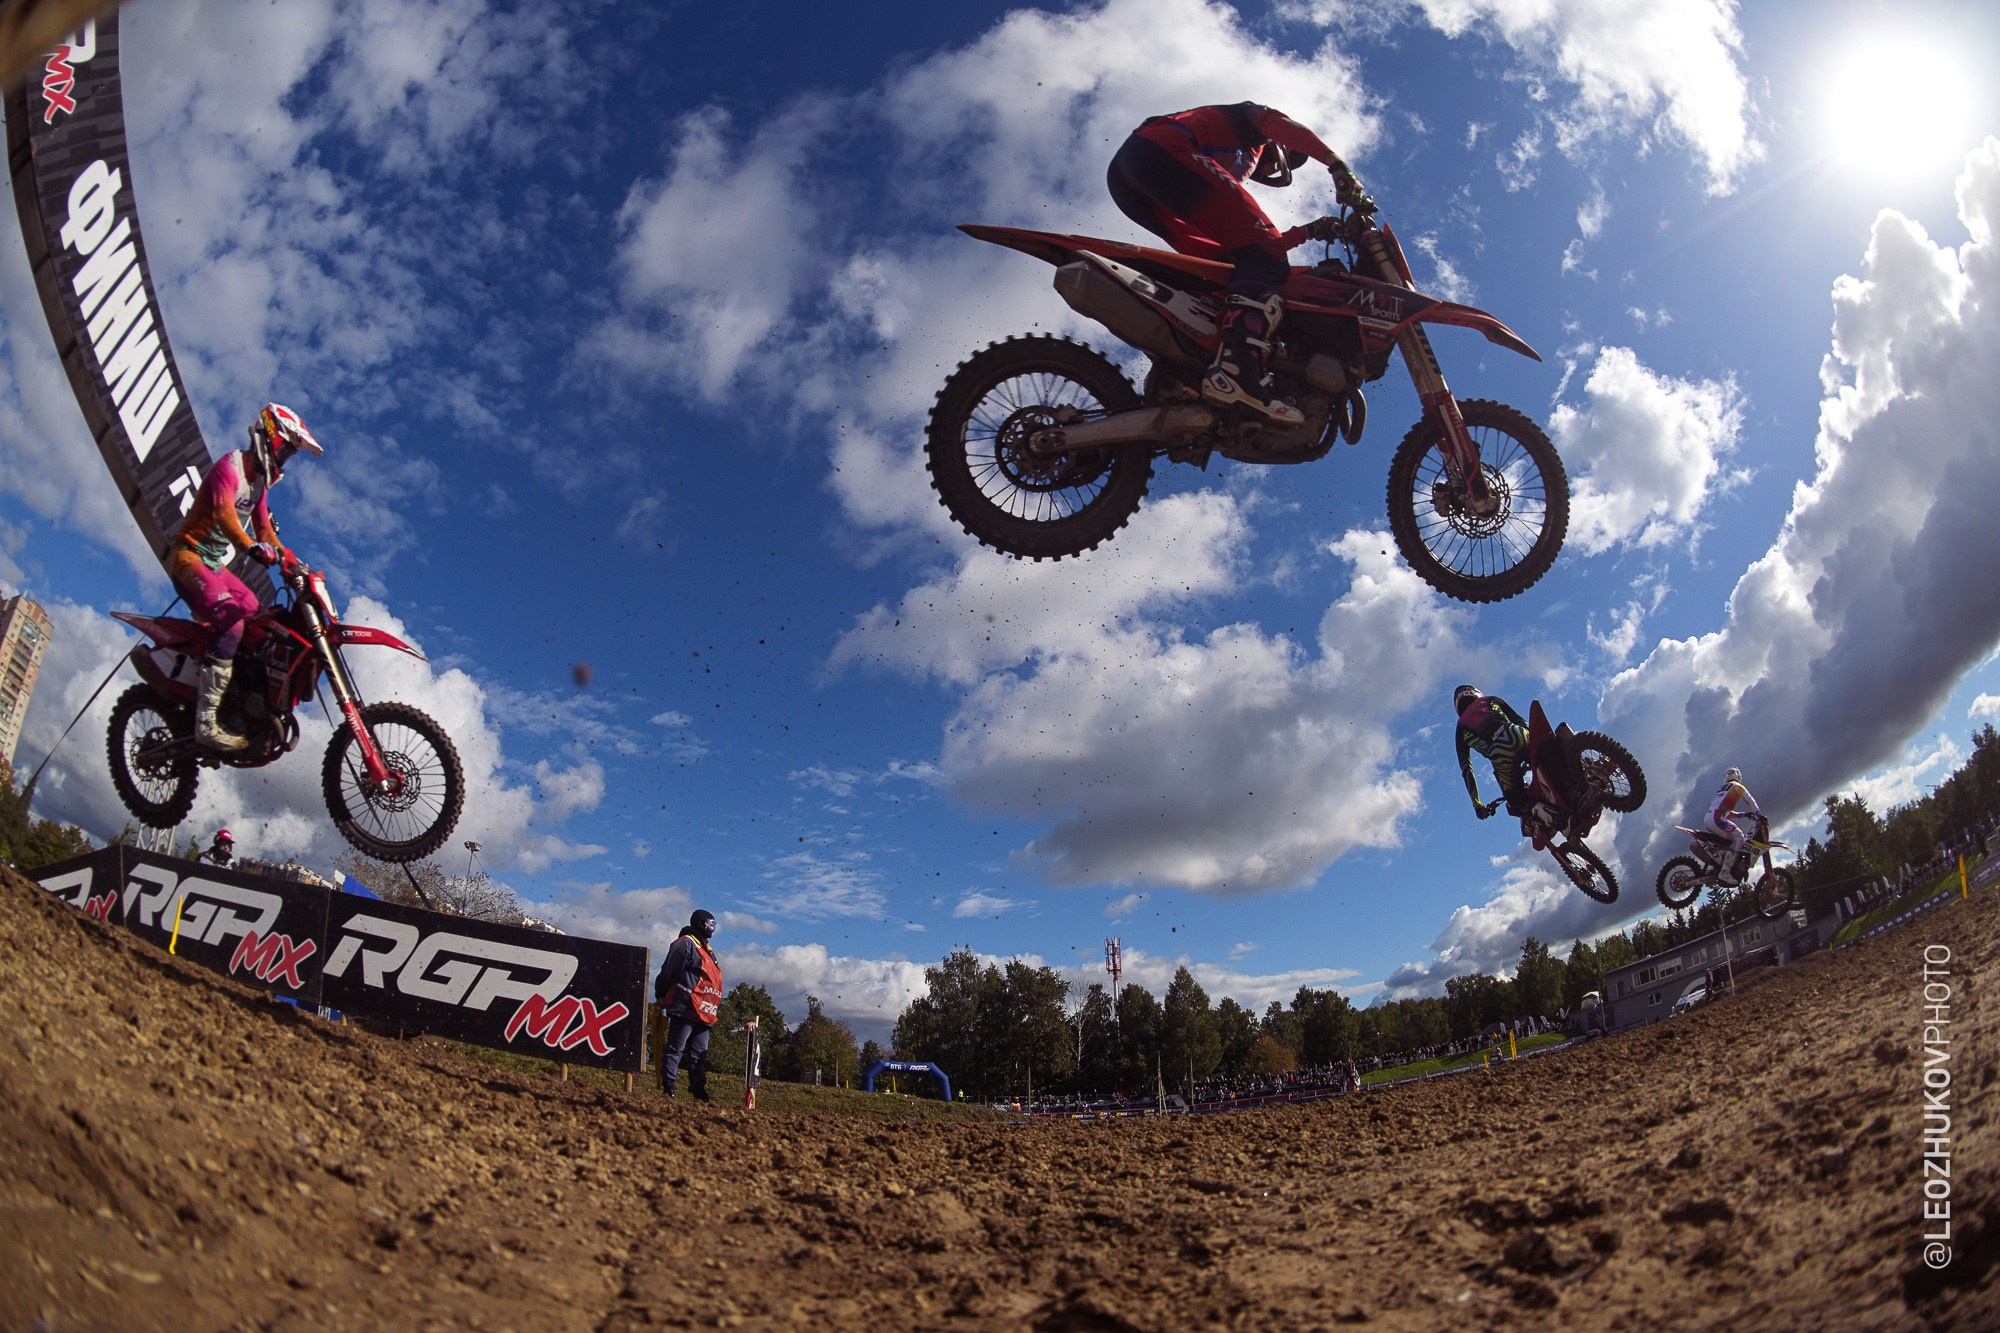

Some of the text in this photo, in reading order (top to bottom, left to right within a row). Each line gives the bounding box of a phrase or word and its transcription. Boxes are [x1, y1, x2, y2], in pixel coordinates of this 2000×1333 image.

[60, 160, 180, 464] ФИНИШ
[1370, 306, 1401, 321] SPORTS
[123, 862, 283, 946] RGP
[229, 930, 318, 990] MX
[322, 913, 630, 1056] RGP MX
